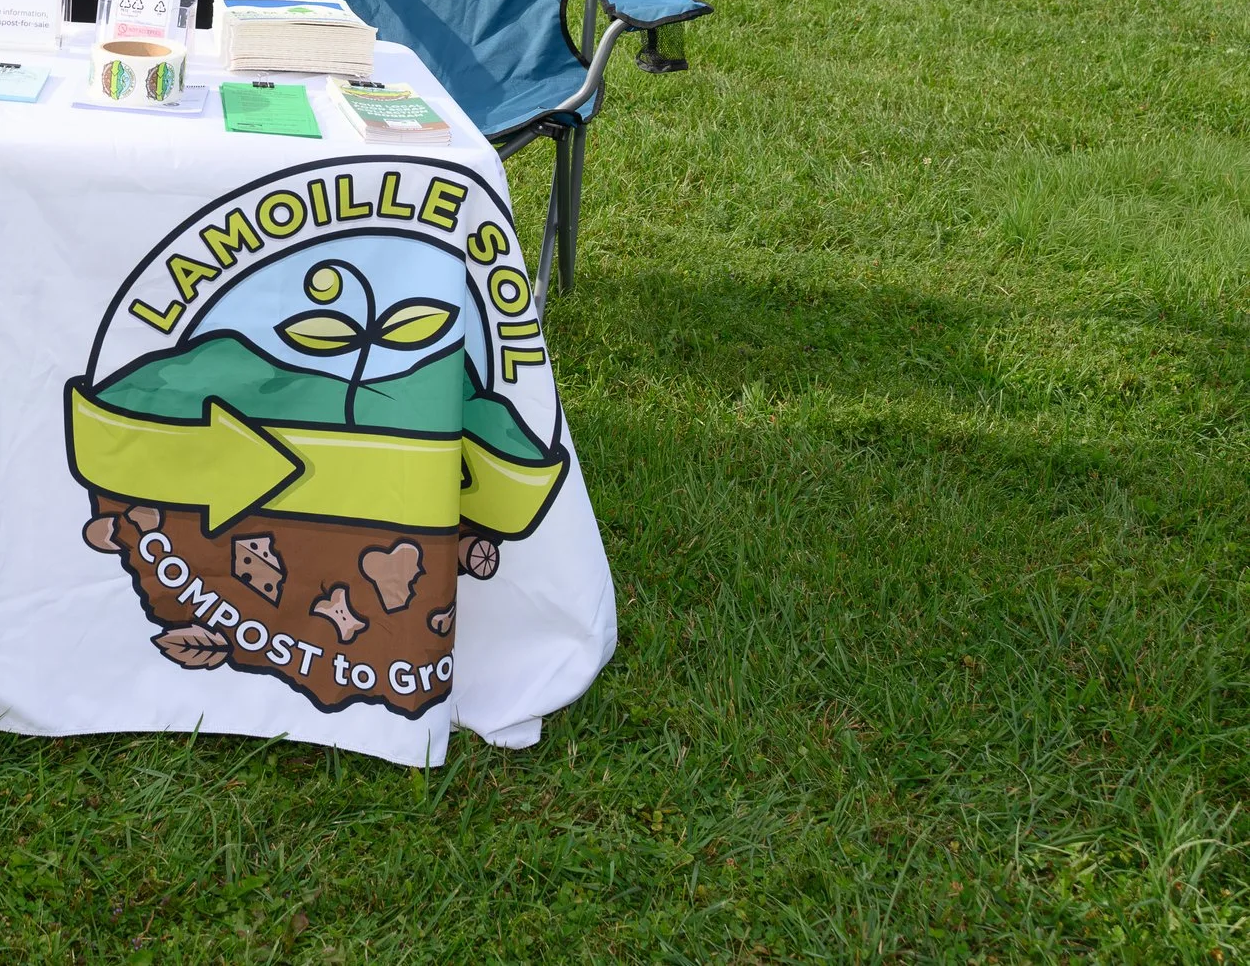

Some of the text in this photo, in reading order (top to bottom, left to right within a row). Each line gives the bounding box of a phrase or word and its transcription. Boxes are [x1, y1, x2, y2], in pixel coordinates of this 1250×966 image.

[2, 8, 49, 19] information,
[128, 170, 547, 386] LAMOILLE SOIL
[137, 530, 454, 695] COMPOST to Gro
